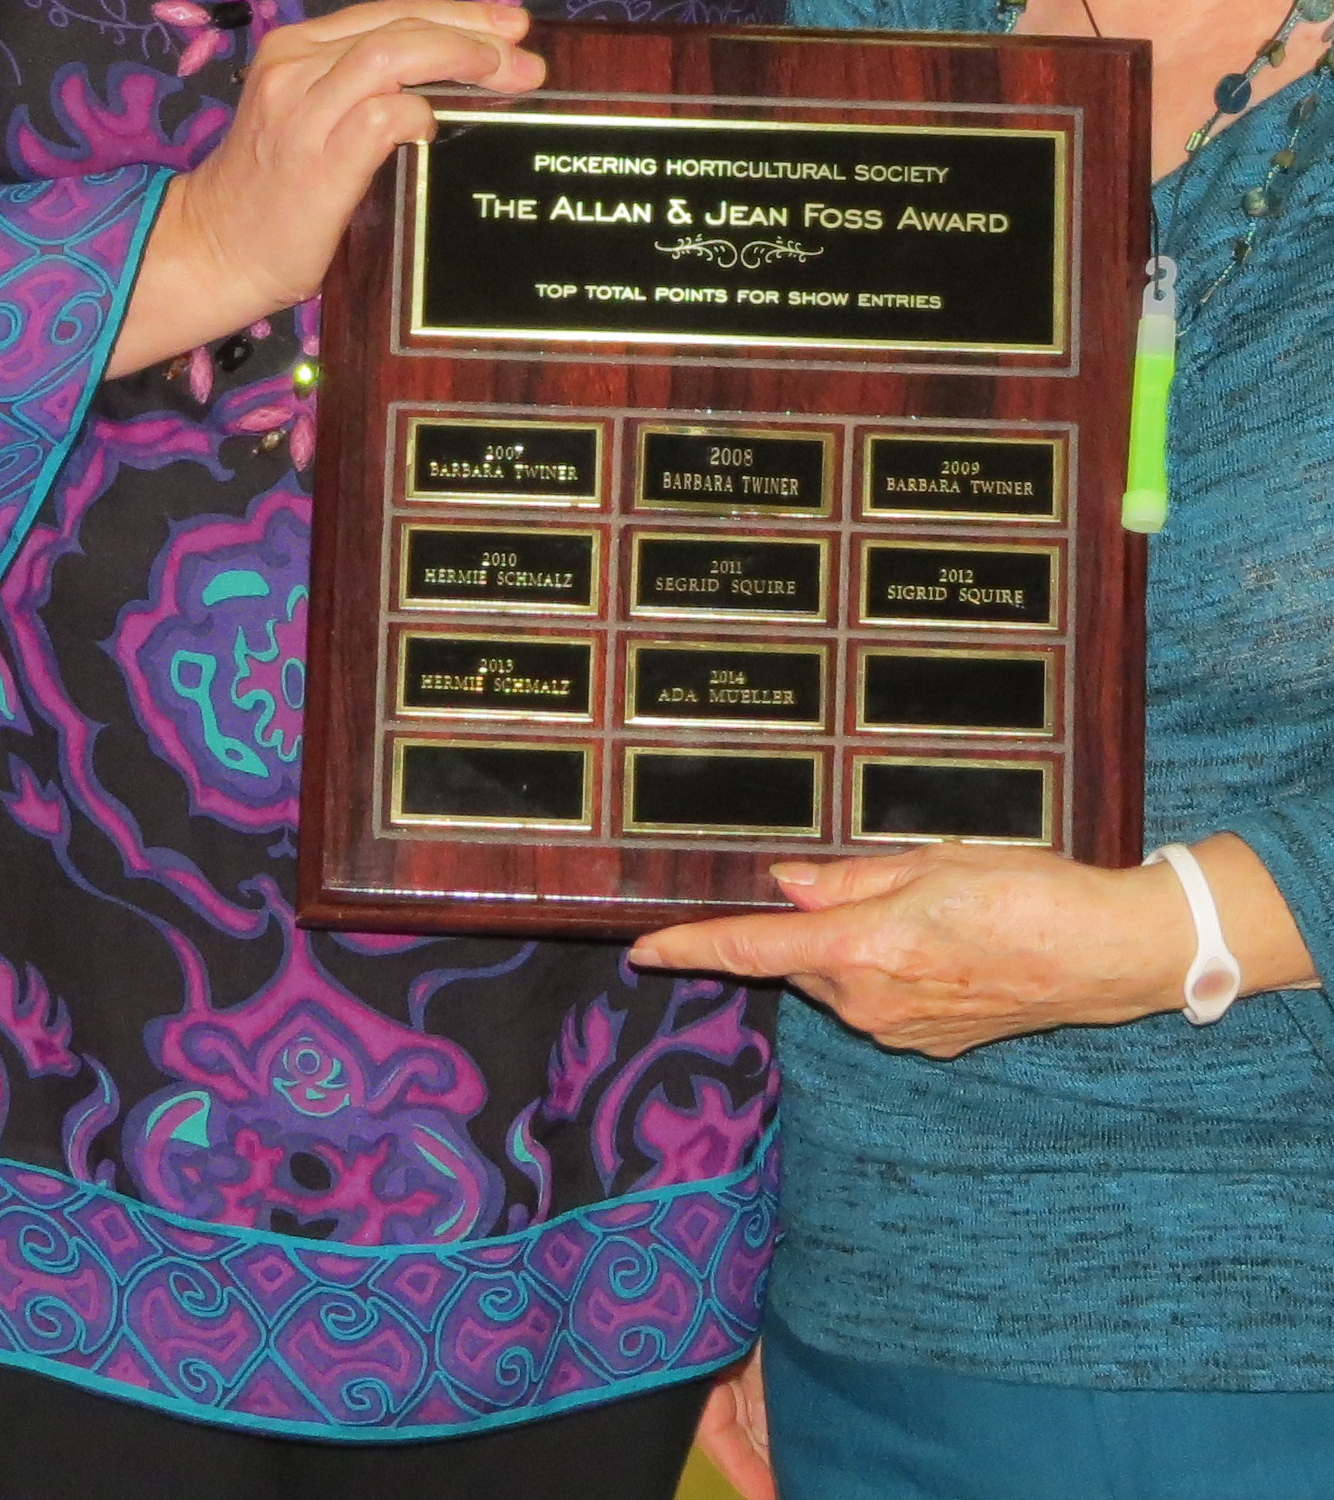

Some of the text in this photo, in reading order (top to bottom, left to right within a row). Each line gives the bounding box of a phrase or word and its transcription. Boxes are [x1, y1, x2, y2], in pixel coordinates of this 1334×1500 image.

[533, 153, 949, 183] PICKERING HORTICULTURAL SOCIETY
[666, 198, 693, 227] &
[535, 284, 941, 309] TOP TOTAL POINTS FOR SHOW ENTRIES
[710, 447, 753, 466] 2008
[430, 461, 578, 481] BARBARA TWINER
[941, 461, 979, 475] 2009
[663, 472, 798, 496] BARBARA TWINER
[887, 477, 1033, 495] BARBARA TWINER
[482, 552, 516, 567] 2010
[710, 561, 741, 574] 2011
[425, 569, 573, 588] HERMIE SCHMALZ
[939, 569, 973, 583] 2012
[656, 577, 795, 595] SEGRID SQUIRE
[888, 585, 1023, 605] SIGRID SQUIRE
[421, 674, 570, 695] HERMIE SCHMALZ
[710, 671, 745, 684] 2014
[658, 688, 794, 704] ADA MUELLER
